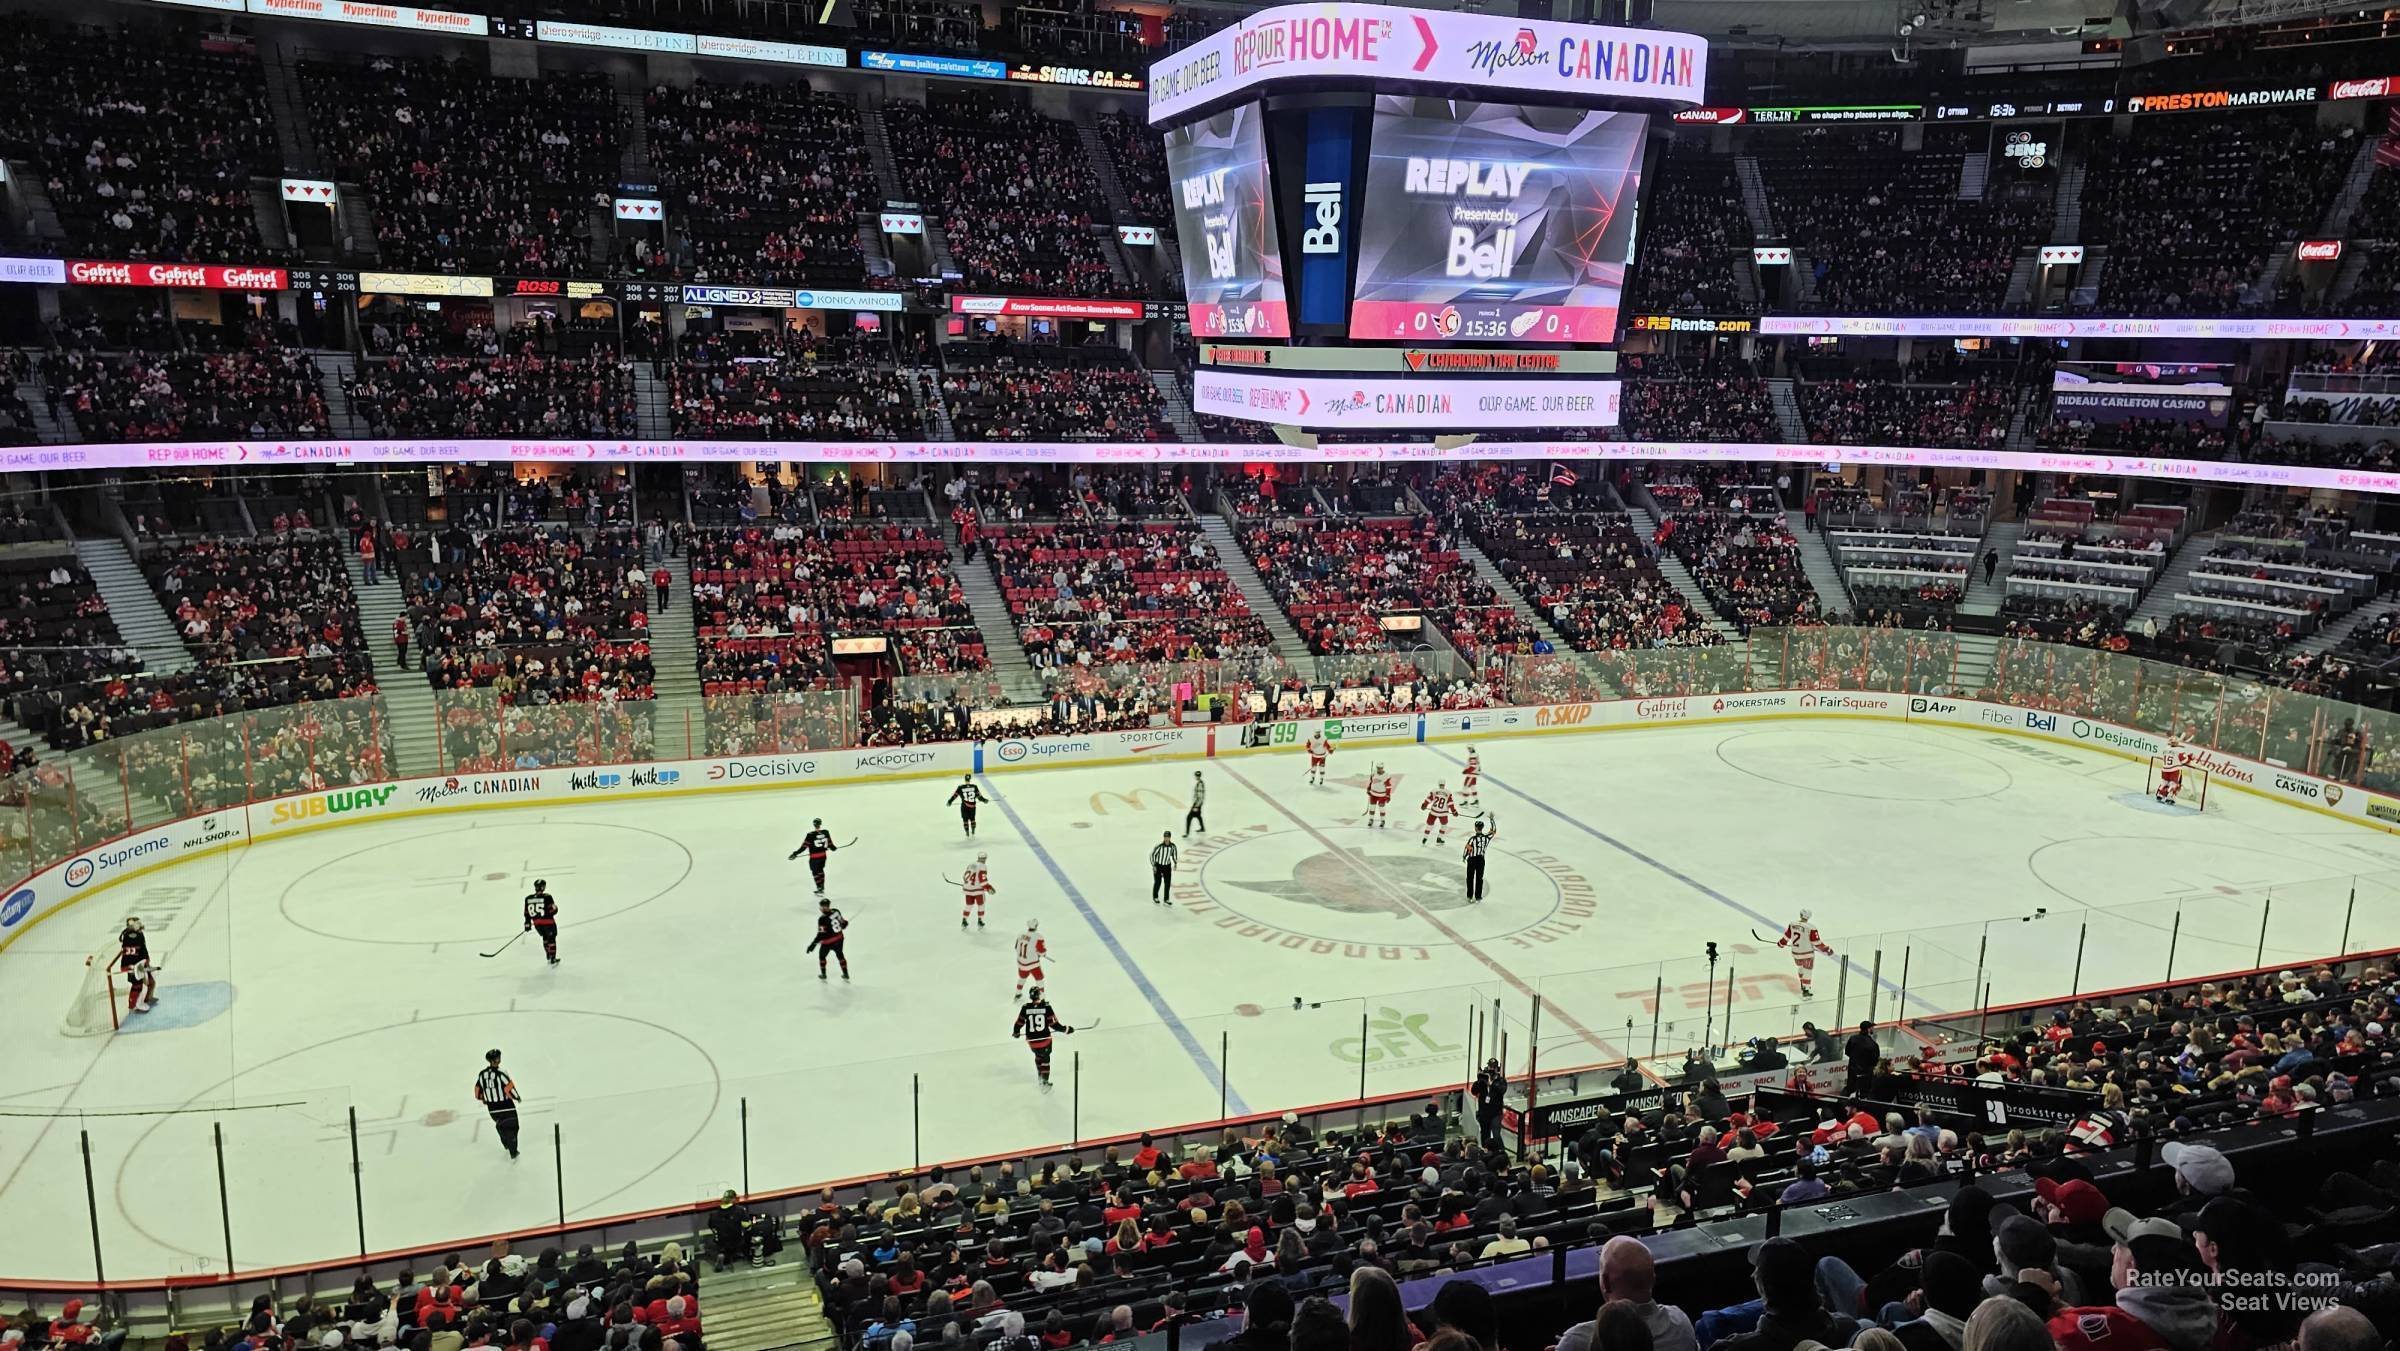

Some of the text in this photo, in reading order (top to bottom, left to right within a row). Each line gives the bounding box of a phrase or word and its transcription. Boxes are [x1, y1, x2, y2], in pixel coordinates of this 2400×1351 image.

[343, 4, 398, 19] Hyperline
[416, 10, 471, 26] Hyperline
[498, 23, 506, 34] 4
[525, 25, 534, 37] 2
[1234, 18, 1379, 77] REP OUR HOME
[1467, 37, 1695, 87] Molson CANADIAN
[1039, 66, 1114, 87] SIGNS.CA
[1183, 61, 1199, 93] OUR
[1937, 106, 1945, 118] 0
[1990, 104, 2016, 116] 15:36
[2104, 100, 2113, 113] 0
[1679, 111, 1718, 121] CANADA
[1822, 112, 1842, 120] shape
[1842, 111, 1854, 119] the
[1854, 111, 1877, 120] places
[1877, 112, 1891, 120] you
[2005, 142, 2047, 157] SENS
[1405, 157, 1529, 198] REPLAY
[1182, 171, 1225, 210] REPLAY
[1302, 182, 1342, 253] Bell
[1454, 207, 1519, 224] Presented by
[1207, 229, 1236, 279] Bell
[1446, 227, 1517, 278] Bell
[72, 263, 130, 279] Gabriel
[149, 266, 206, 282] Gabriel
[223, 269, 277, 284] Gabriel
[292, 271, 354, 281] 305 306
[293, 281, 355, 291] 205 206
[516, 280, 561, 293] ROSS
[567, 282, 603, 290] PRODUCTION
[664, 285, 679, 294] 307
[626, 293, 679, 302] 206 207
[684, 288, 750, 303] ALIGNED
[817, 296, 901, 307] KONICA MINOLTA
[1011, 303, 1031, 311] Know
[1031, 304, 1056, 312] Sooner.
[1088, 306, 1113, 314] Remove
[1113, 306, 1134, 315] Waste.
[1496, 308, 1500, 318] 1
[1209, 312, 1216, 329] 0
[1258, 311, 1265, 328] 0
[1397, 312, 1428, 331] 4 0
[1546, 315, 1570, 334] 0 2
[1465, 321, 1507, 337] 15:36
[2112, 323, 2160, 333] CANADIAN
[2268, 324, 2330, 335] REP HOME
[1429, 353, 1491, 368] CANADIAN
[1518, 354, 1560, 369] CENTRE
[1376, 393, 1452, 414] CANADIAN
[1479, 396, 1501, 412] OUR
[1542, 396, 1565, 412] OUR
[2056, 396, 2206, 411] RIDEAU CARLETON CASINO
[148, 449, 225, 461] REP HOME
[295, 446, 351, 458] CANADIAN
[1637, 698, 1687, 717] Gabriel
[1726, 698, 1786, 708] POKERSTARS
[1819, 697, 1888, 710] FairSquare
[1551, 704, 1592, 725] SKIP
[1651, 711, 1687, 719] PIZZA
[1982, 708, 2013, 725] Fibe
[2026, 712, 2056, 732] Bell
[1120, 731, 1184, 743] SPORTCHEK
[1274, 722, 1298, 744] 99
[1325, 719, 1408, 739] enterprise
[1031, 741, 1091, 756] Supreme
[2094, 727, 2159, 754] Desjardins
[856, 752, 936, 769] JACKPOTCITY
[2163, 755, 2173, 766] 15
[2193, 750, 2254, 784] Hortons
[729, 759, 815, 779] Decisive
[416, 777, 540, 804] Molson CANADIAN
[2275, 779, 2319, 798] CASINO
[271, 783, 398, 825] SUBWAY
[963, 791, 976, 803] 12
[1433, 795, 1446, 808] 28
[183, 830, 240, 849] NHLSHOP.CA
[98, 836, 169, 870] Supreme
[963, 870, 976, 885] 24
[528, 903, 545, 918] 85
[1791, 932, 1801, 947] 2
[1019, 942, 1029, 959] 11
[1028, 1014, 1047, 1033] 19
[1329, 1013, 1463, 1063] GFL
[1753, 1075, 1776, 1086] BRICK
[1626, 1091, 1684, 1111] MANSCAED
[2083, 1119, 2106, 1145] 7
